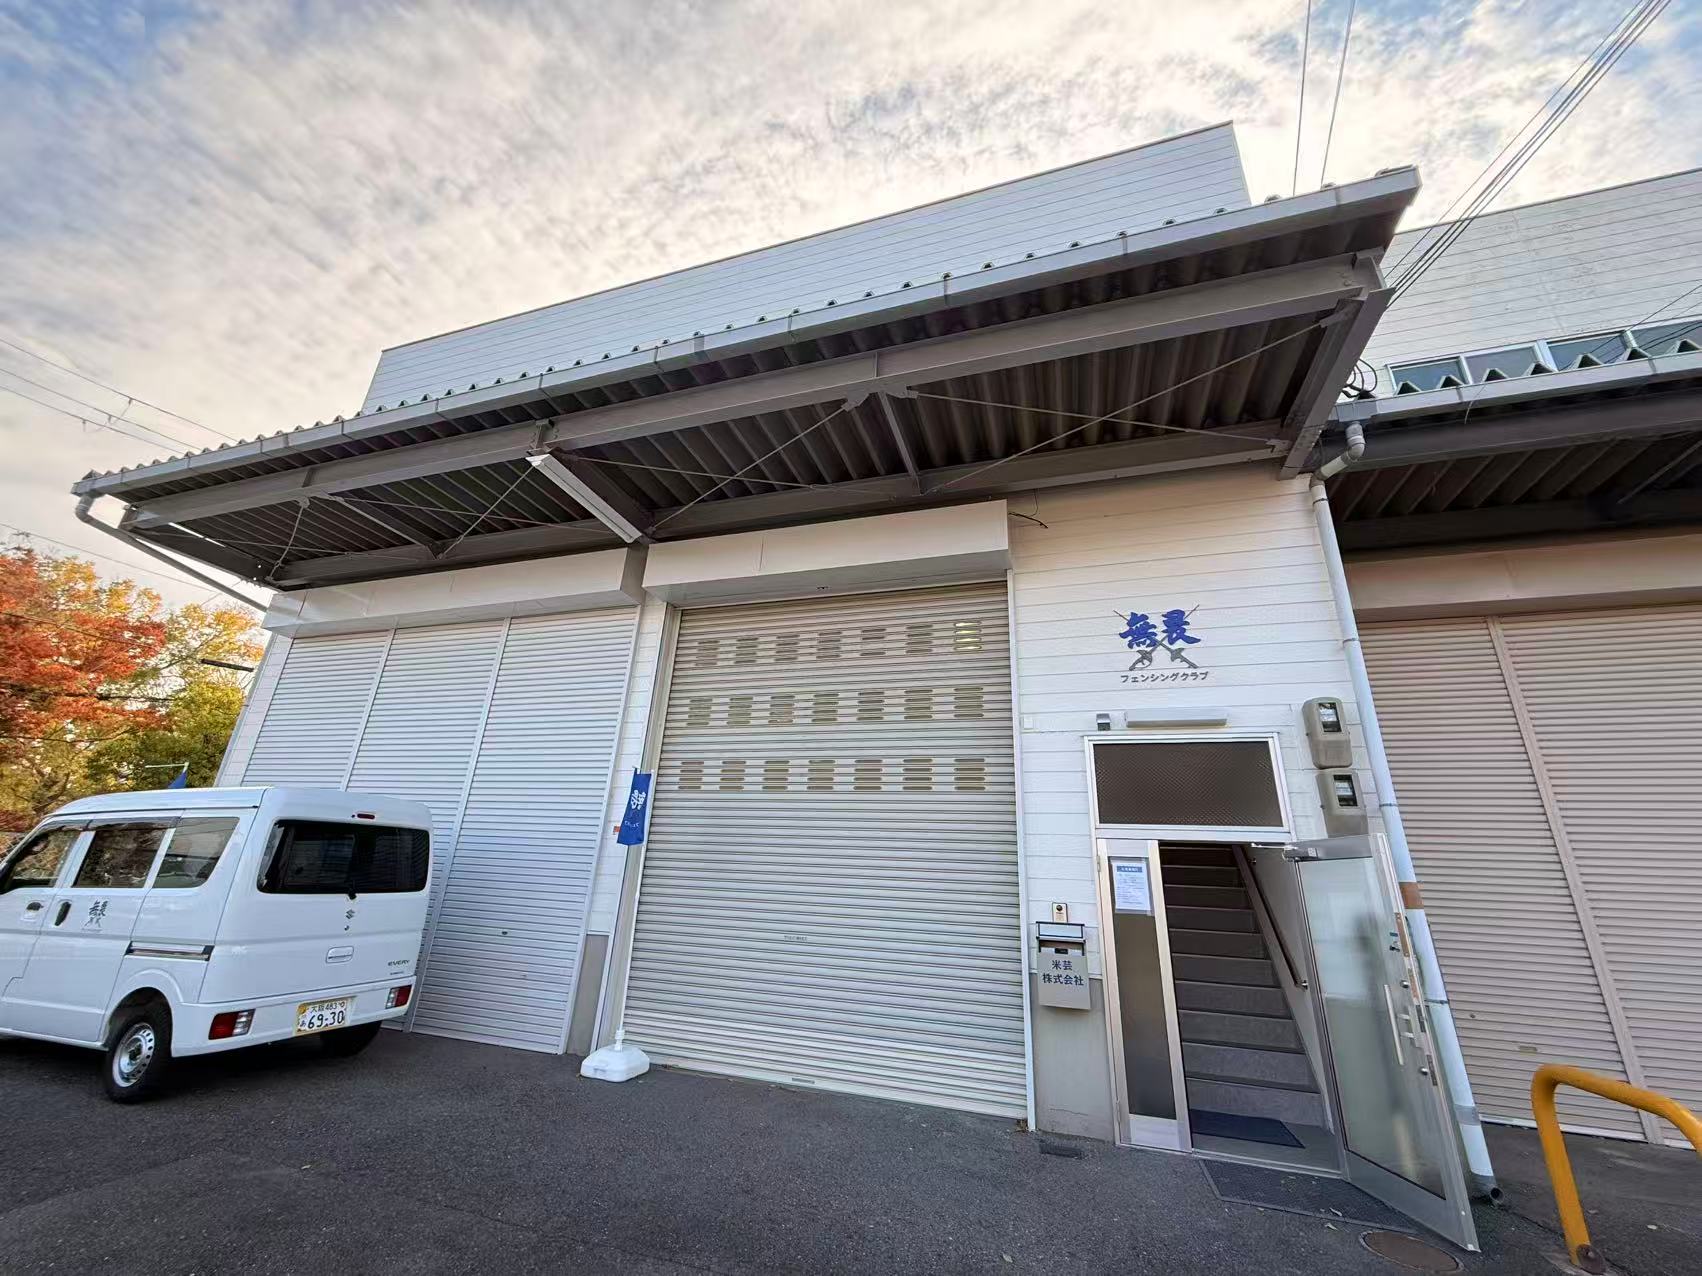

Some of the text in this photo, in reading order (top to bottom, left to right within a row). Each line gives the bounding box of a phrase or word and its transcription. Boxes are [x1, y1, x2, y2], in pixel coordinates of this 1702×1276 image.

[1051, 959, 1073, 970] 米芸
[1042, 973, 1084, 986] 株式会社
